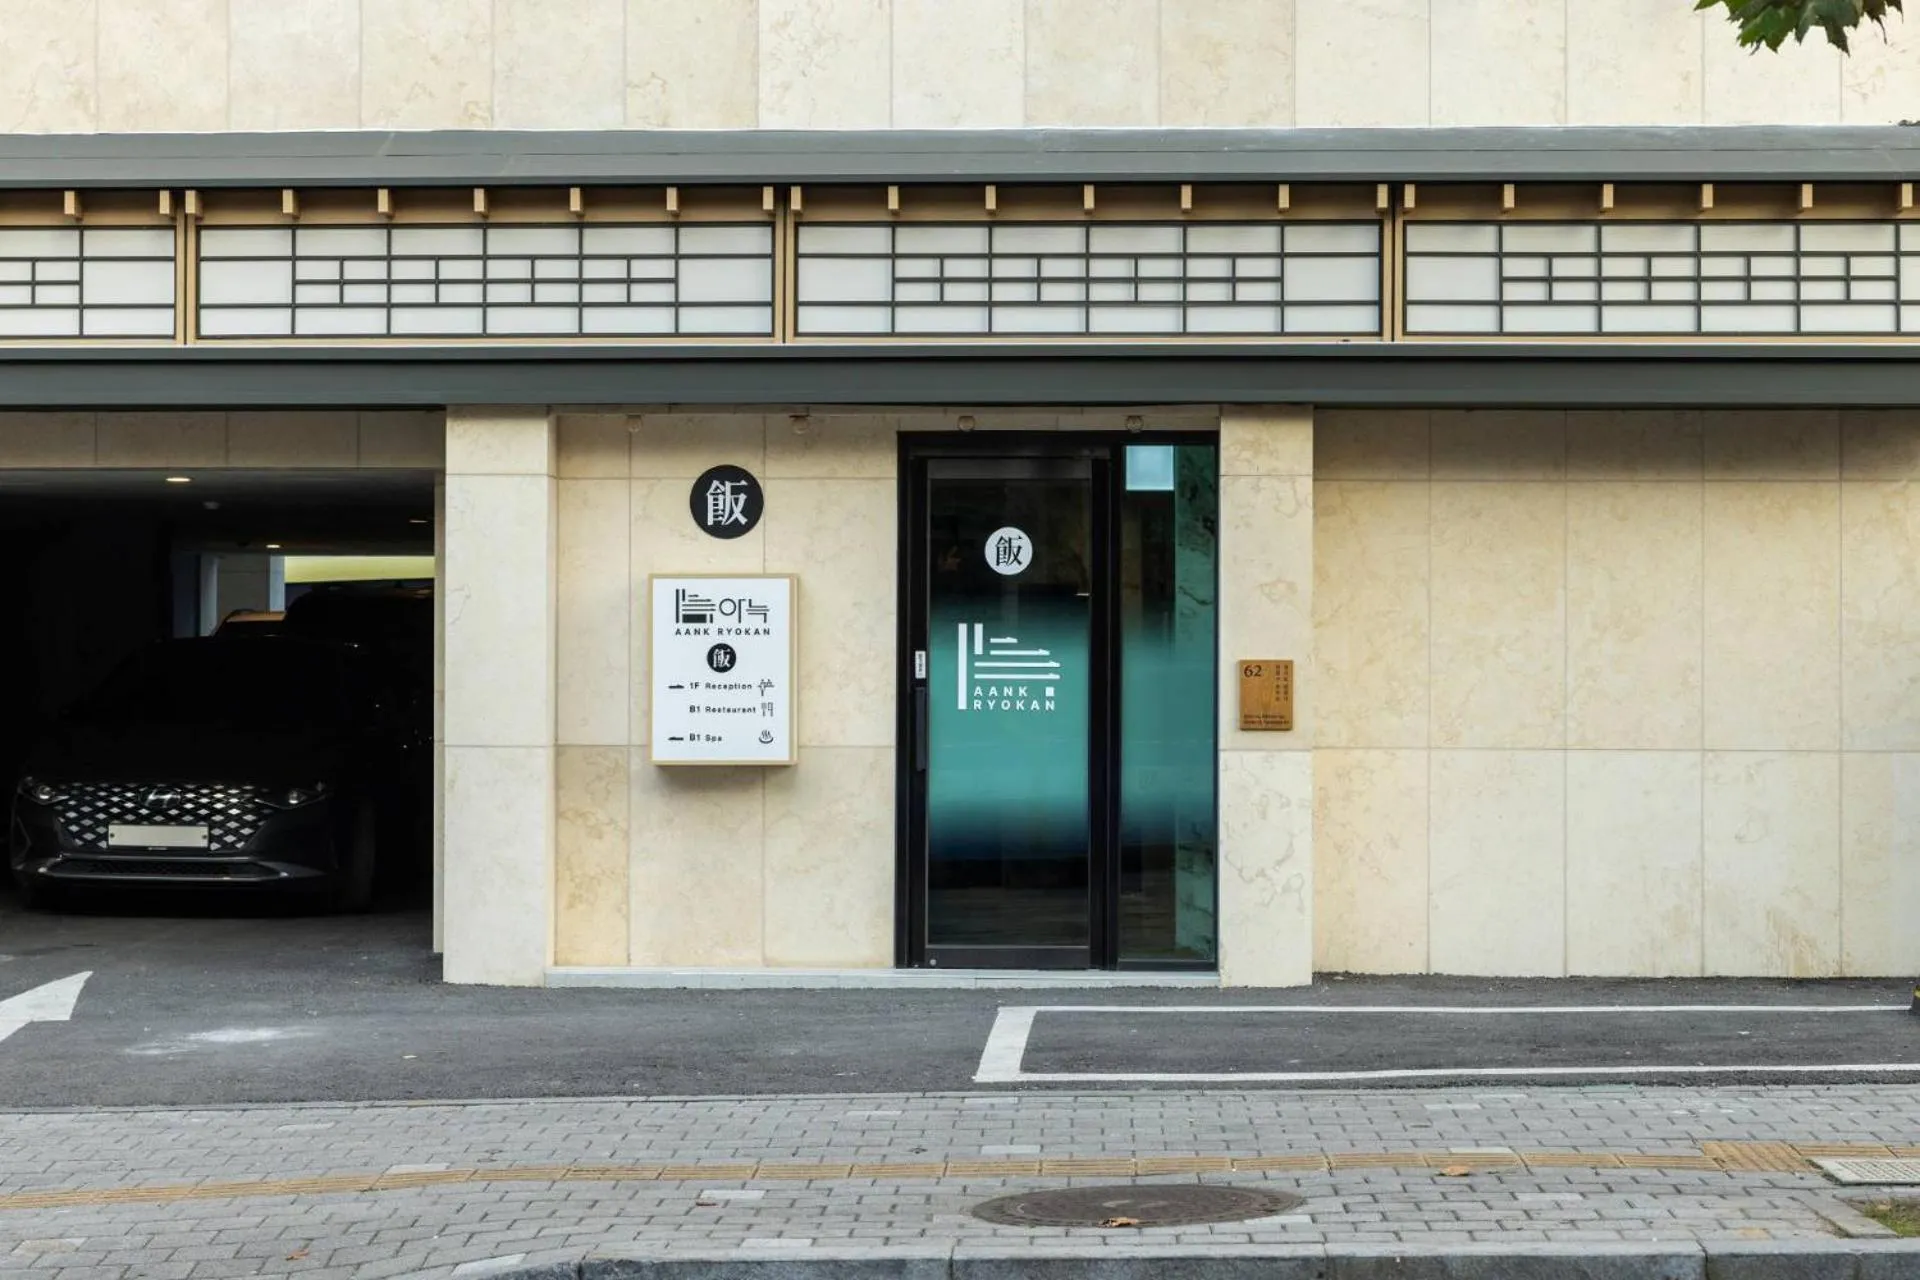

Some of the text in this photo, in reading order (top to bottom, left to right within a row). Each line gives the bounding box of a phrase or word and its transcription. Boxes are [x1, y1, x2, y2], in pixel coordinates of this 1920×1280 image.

[706, 479, 749, 526] 飯
[994, 535, 1024, 567] 飯
[675, 628, 771, 636] AANK RYOKAN
[713, 648, 731, 668] 飯
[1243, 664, 1262, 678] 62
[690, 681, 753, 691] 1F Reception
[974, 686, 1029, 697] AANK
[689, 704, 756, 713] B1 Restaurant
[974, 699, 1055, 710] RYOKAN
[689, 733, 722, 743] B1 Spa
